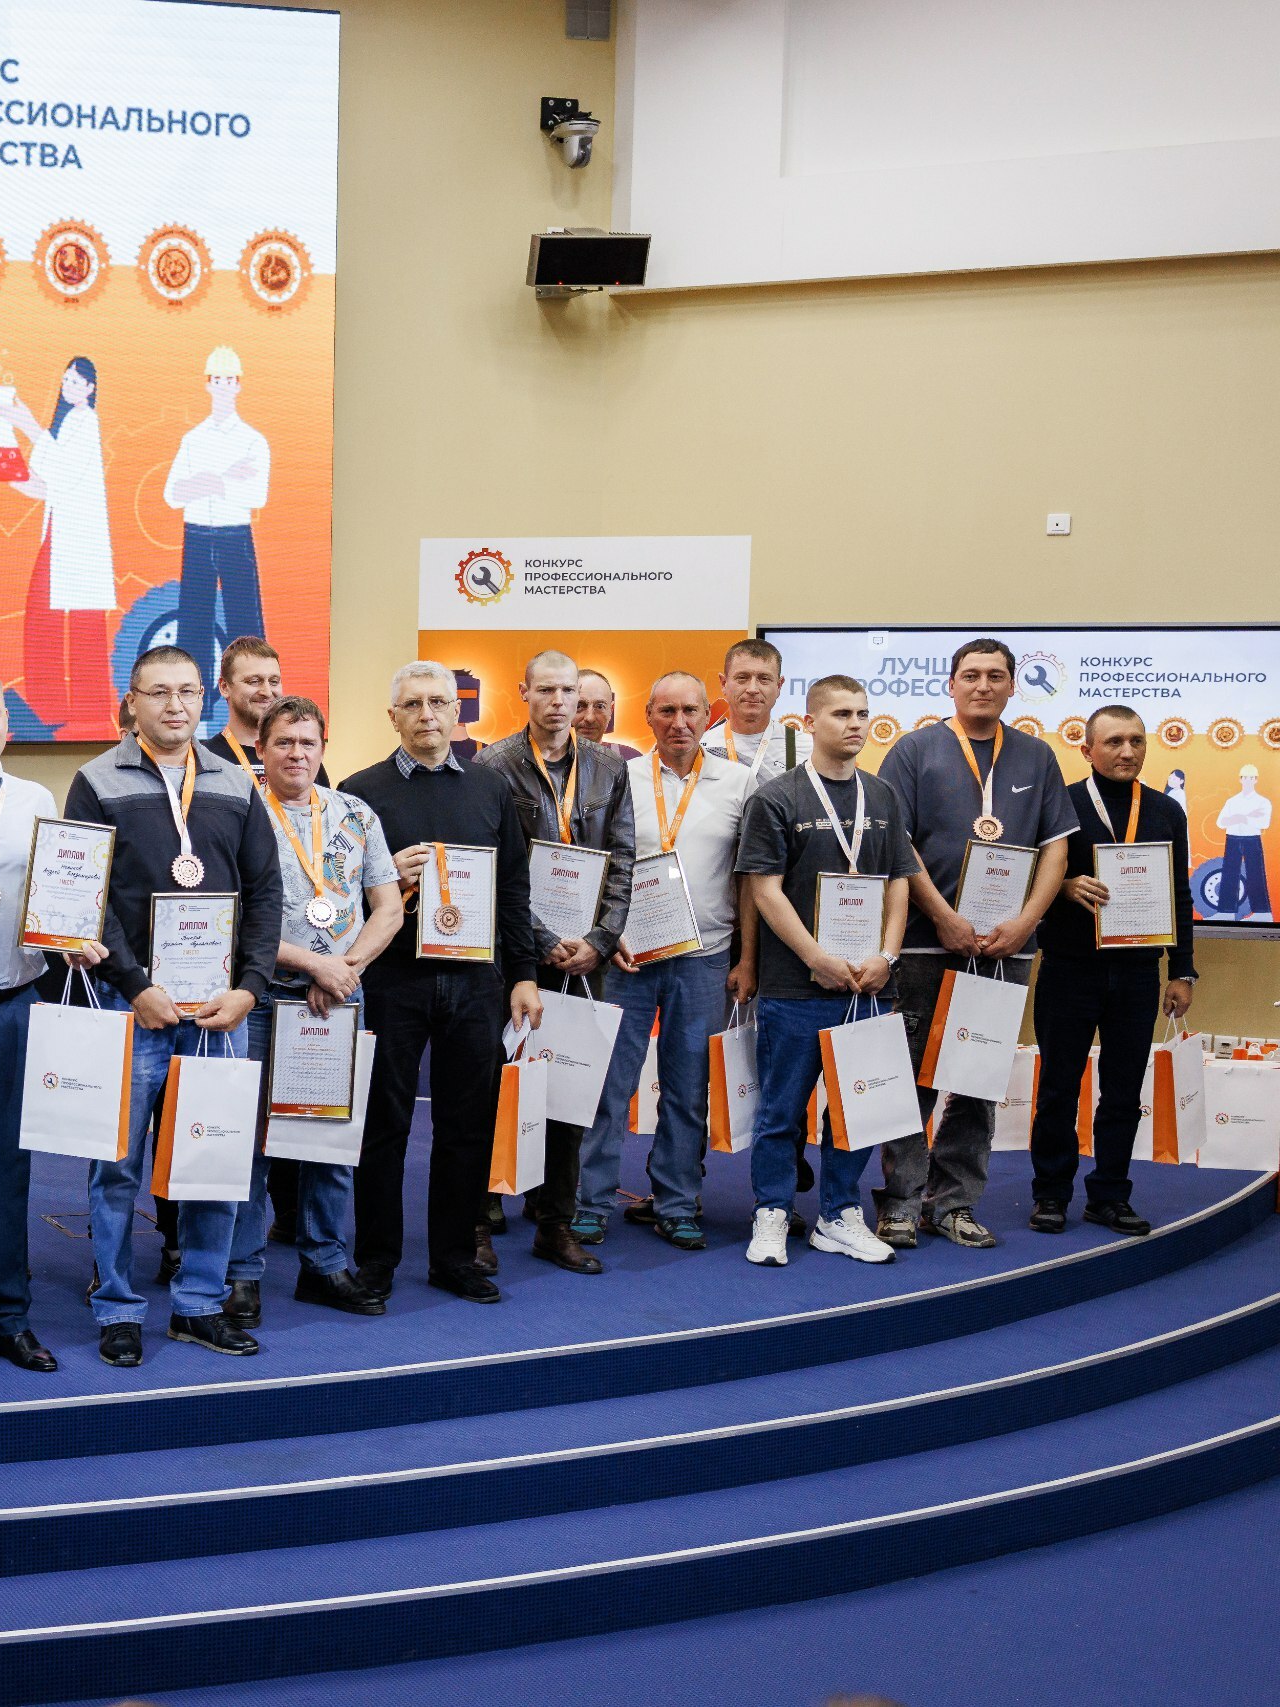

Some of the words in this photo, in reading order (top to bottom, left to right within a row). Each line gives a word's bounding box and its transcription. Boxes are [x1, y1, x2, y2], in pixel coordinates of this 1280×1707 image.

[524, 559, 583, 568] КОНКУРС
[524, 571, 673, 582] ПРОФЕССИОНАЛЬНОГО
[524, 585, 606, 595] МАСТЕРСТВА
[877, 657, 951, 676] ЛУЧШ
[1080, 656, 1153, 667] КОНКУРС
[1079, 672, 1267, 684] ПРОФЕССИОНАЛЬНОГО
[1079, 687, 1181, 698] МАСТЕРСТВА
[57, 848, 86, 861] ДИПЛОМ
[447, 870, 471, 879] ИПЛОМ
[550, 867, 580, 879] ДИПЛОМ
[985, 866, 1010, 877] ДИПЛОМ
[1120, 866, 1147, 875] ДИПЛОМ
[633, 877, 660, 892] ДИПЛОМ
[838, 897, 864, 907] ДИПЛОМ
[179, 921, 208, 931] ДИПЛОМ
[300, 1026, 330, 1036] ДИПЛОМ
